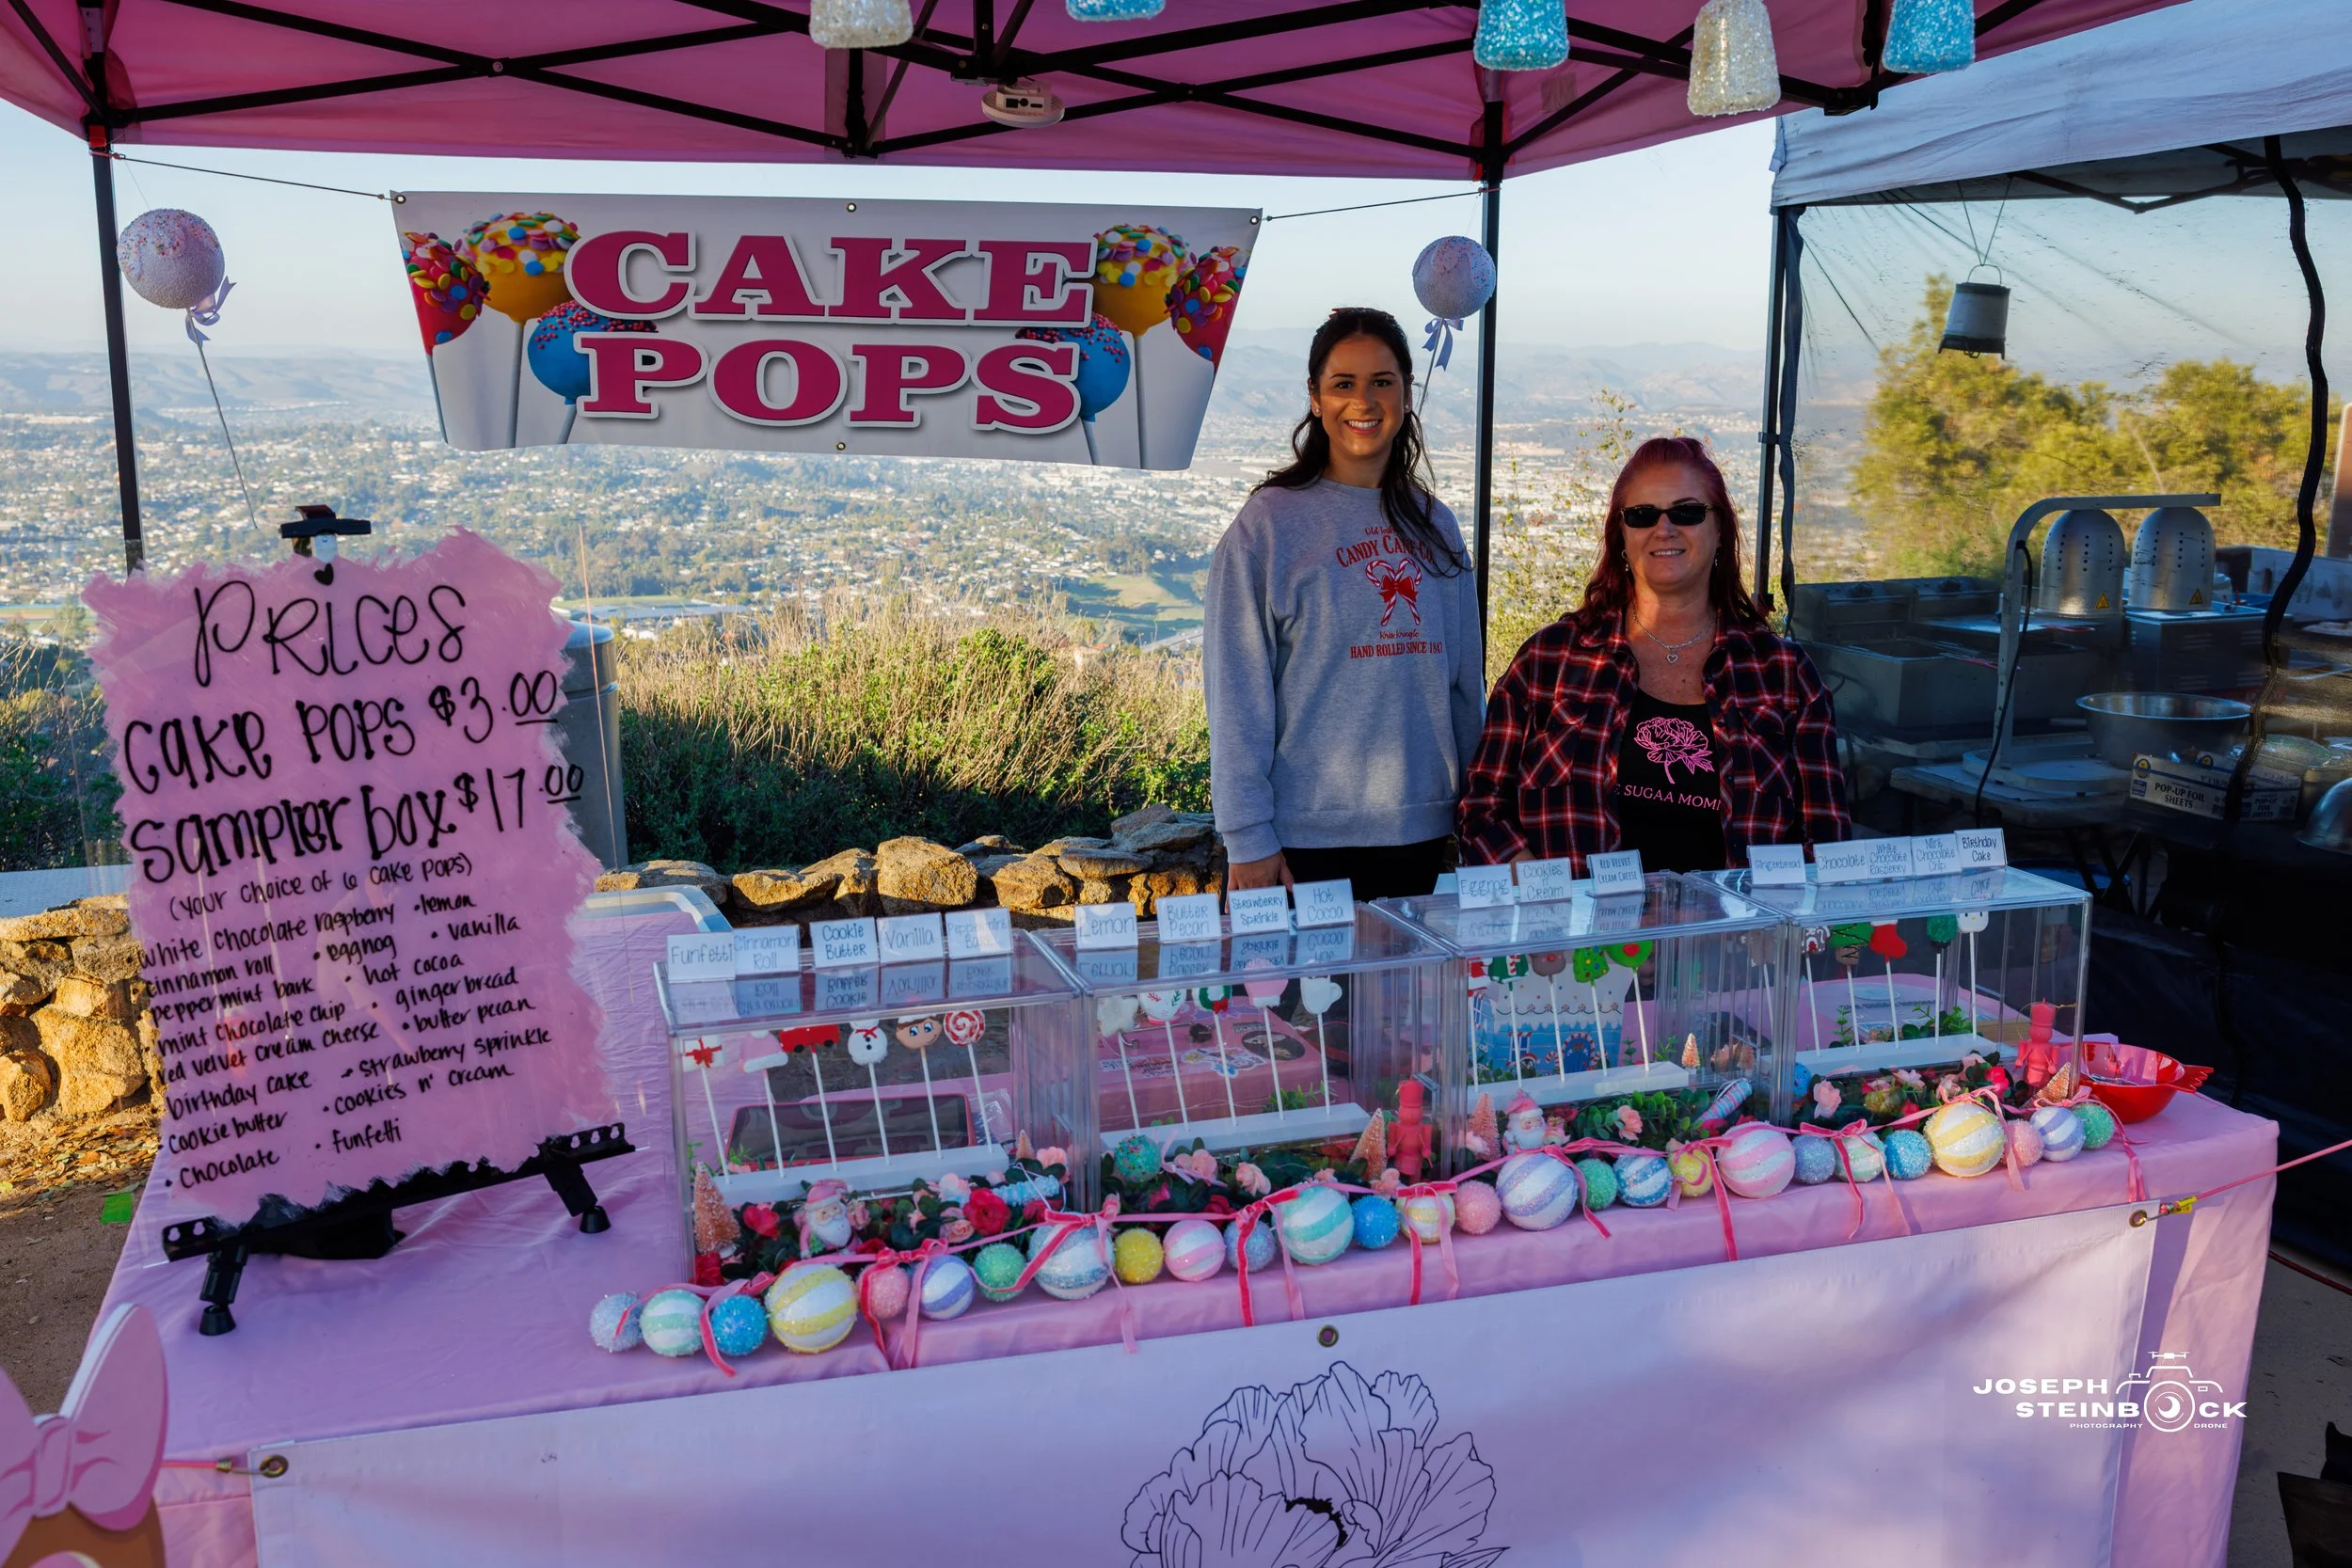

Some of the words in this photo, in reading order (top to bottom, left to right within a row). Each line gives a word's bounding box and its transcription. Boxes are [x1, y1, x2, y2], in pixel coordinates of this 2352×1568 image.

[568, 227, 1096, 325] CAKE
[577, 335, 1079, 431] POPS
[1336, 540, 1379, 568] CANDY
[1350, 644, 1374, 658] HAND
[1376, 642, 1405, 657] ROLLED
[1406, 641, 1427, 654] SINCE
[1624, 784, 1674, 803] SUGAA
[2154, 782, 2186, 799] POP-UP
[2187, 790, 2206, 803] FOIL
[2165, 794, 2194, 810] SHEETS
[1611, 857, 1631, 867] VELVET
[1818, 854, 1866, 871] Chocolate
[1972, 850, 1992, 862] Cake
[311, 869, 332, 893] of
[1597, 872, 1617, 883] CREAM
[1618, 870, 1638, 882] CHEESE
[420, 894, 477, 915] lemon
[1313, 888, 1334, 904] Hot
[314, 903, 395, 936] raspberry
[1079, 914, 1135, 937] Lemon
[1307, 905, 1344, 922] Cocoa
[448, 912, 522, 941] vanilla
[822, 923, 866, 942] Cookie
[884, 926, 935, 950] Vanilla
[1169, 920, 1210, 937] Pecan
[326, 934, 397, 965] eggnog
[671, 942, 733, 965] Funfetti
[754, 952, 777, 970] Roll
[144, 964, 239, 999] cinnamon
[245, 954, 273, 976] roll
[363, 962, 401, 986] hot
[414, 953, 465, 976] cocoa
[151, 987, 263, 1028] peppermint
[274, 977, 315, 1001] bark
[414, 1007, 471, 1034] butter
[477, 997, 536, 1023] pecan
[157, 1026, 208, 1058] mint
[310, 1002, 346, 1025] chip
[157, 1060, 186, 1085] red
[192, 1049, 249, 1078] velvet
[255, 1037, 316, 1062] cream
[323, 1022, 381, 1049] cheese
[359, 1043, 465, 1078] strawberry
[474, 1027, 553, 1058] sprinkle
[166, 1082, 258, 1121] birthday
[234, 1111, 288, 1138] butter
[332, 1117, 402, 1154] funfetti
